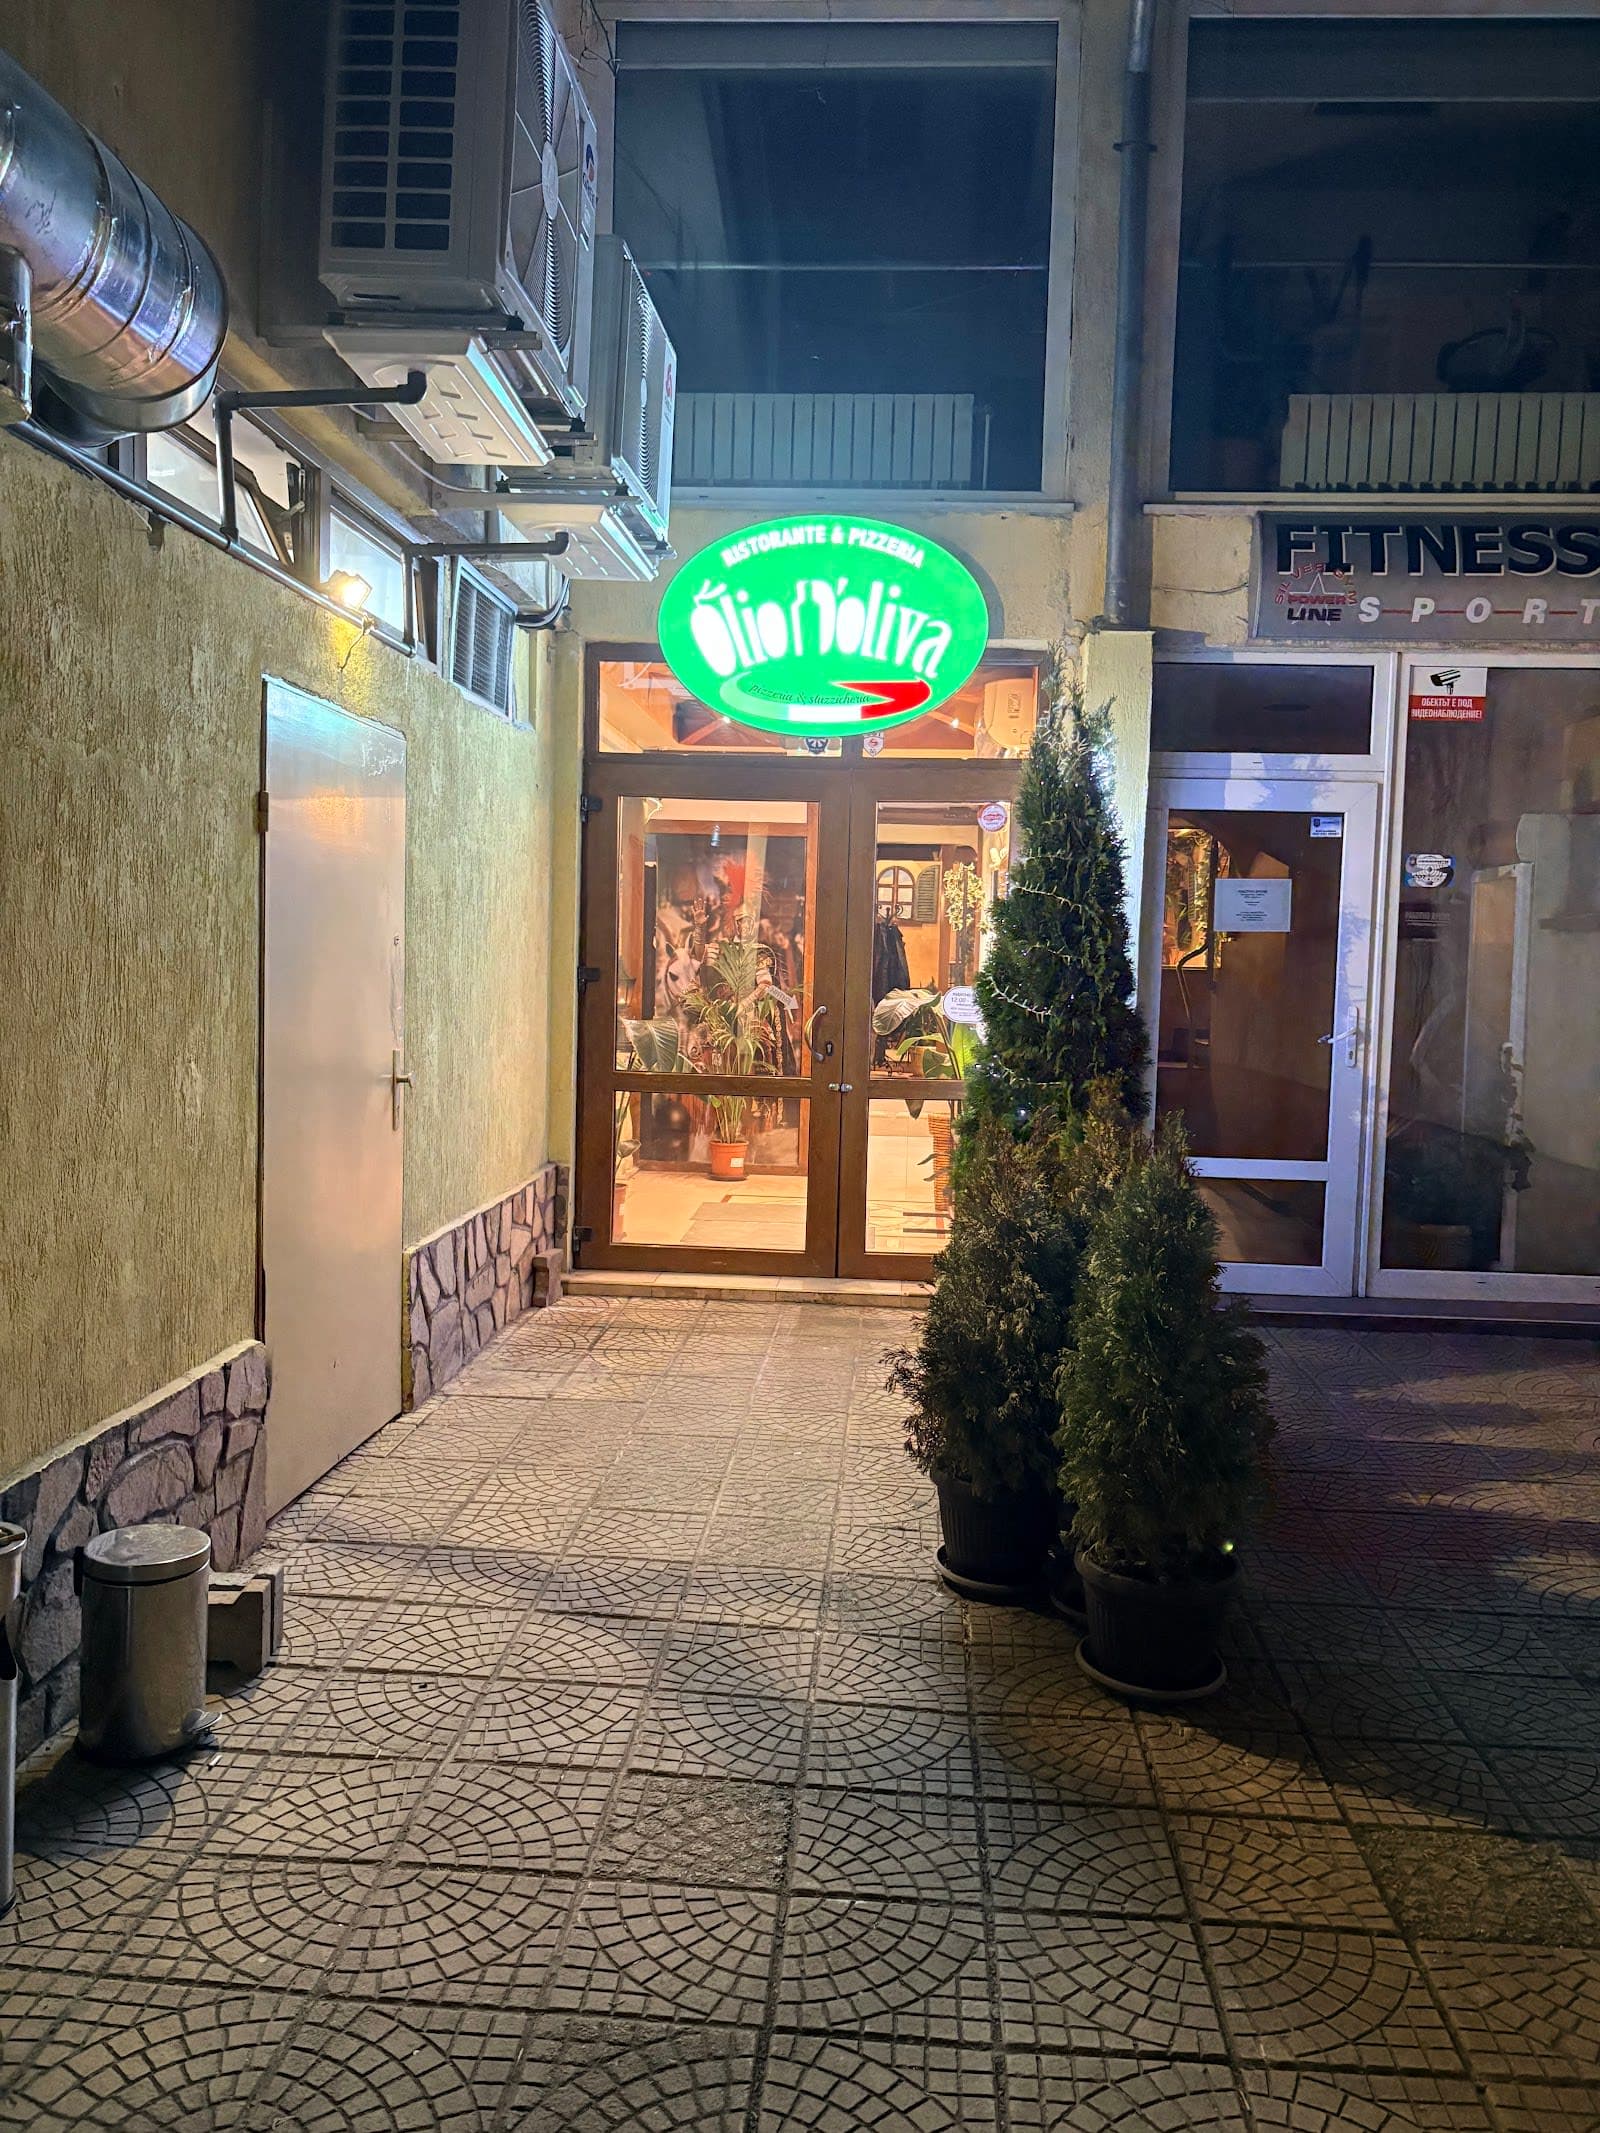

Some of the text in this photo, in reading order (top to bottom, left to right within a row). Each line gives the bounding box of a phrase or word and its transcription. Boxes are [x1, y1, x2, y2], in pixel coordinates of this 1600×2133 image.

[720, 525, 827, 568] RISTORANTE
[848, 527, 925, 568] PIZZERIA
[1276, 523, 1600, 578] FITNESS
[1288, 594, 1346, 604] POWER
[1287, 608, 1342, 621] LINE
[748, 683, 793, 702] pizzeria
[1457, 699, 1473, 708] ПОД
